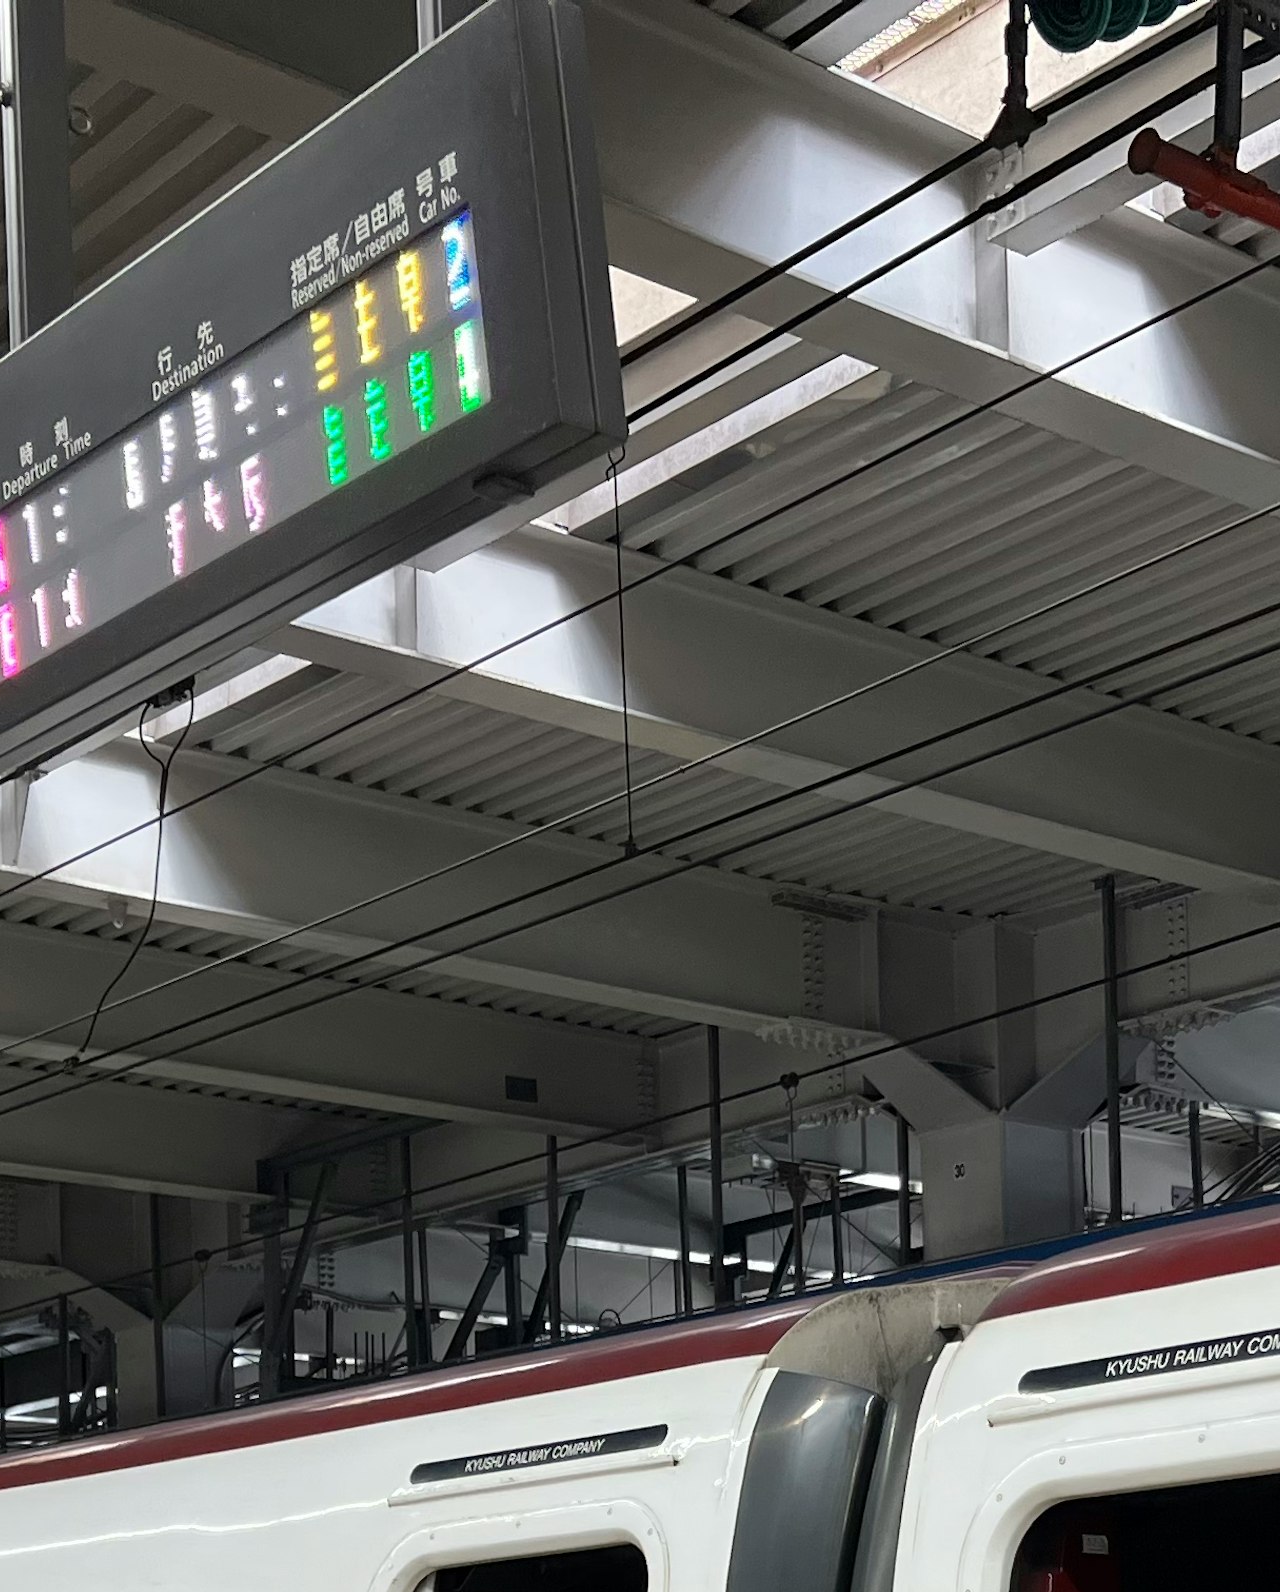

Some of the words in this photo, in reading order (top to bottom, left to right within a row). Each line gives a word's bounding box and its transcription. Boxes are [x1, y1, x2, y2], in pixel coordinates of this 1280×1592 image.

[419, 198, 438, 224] Car
[440, 185, 461, 211] No.
[151, 343, 225, 402] Destination
[2, 454, 59, 500] Departure
[62, 432, 92, 461] Time
[1104, 1351, 1171, 1378] KYUSHU
[1173, 1339, 1244, 1368] RAILWAY
[464, 1455, 506, 1473] KYUSHU
[506, 1445, 552, 1467] RAILWAY
[552, 1438, 607, 1458] COMPANY
